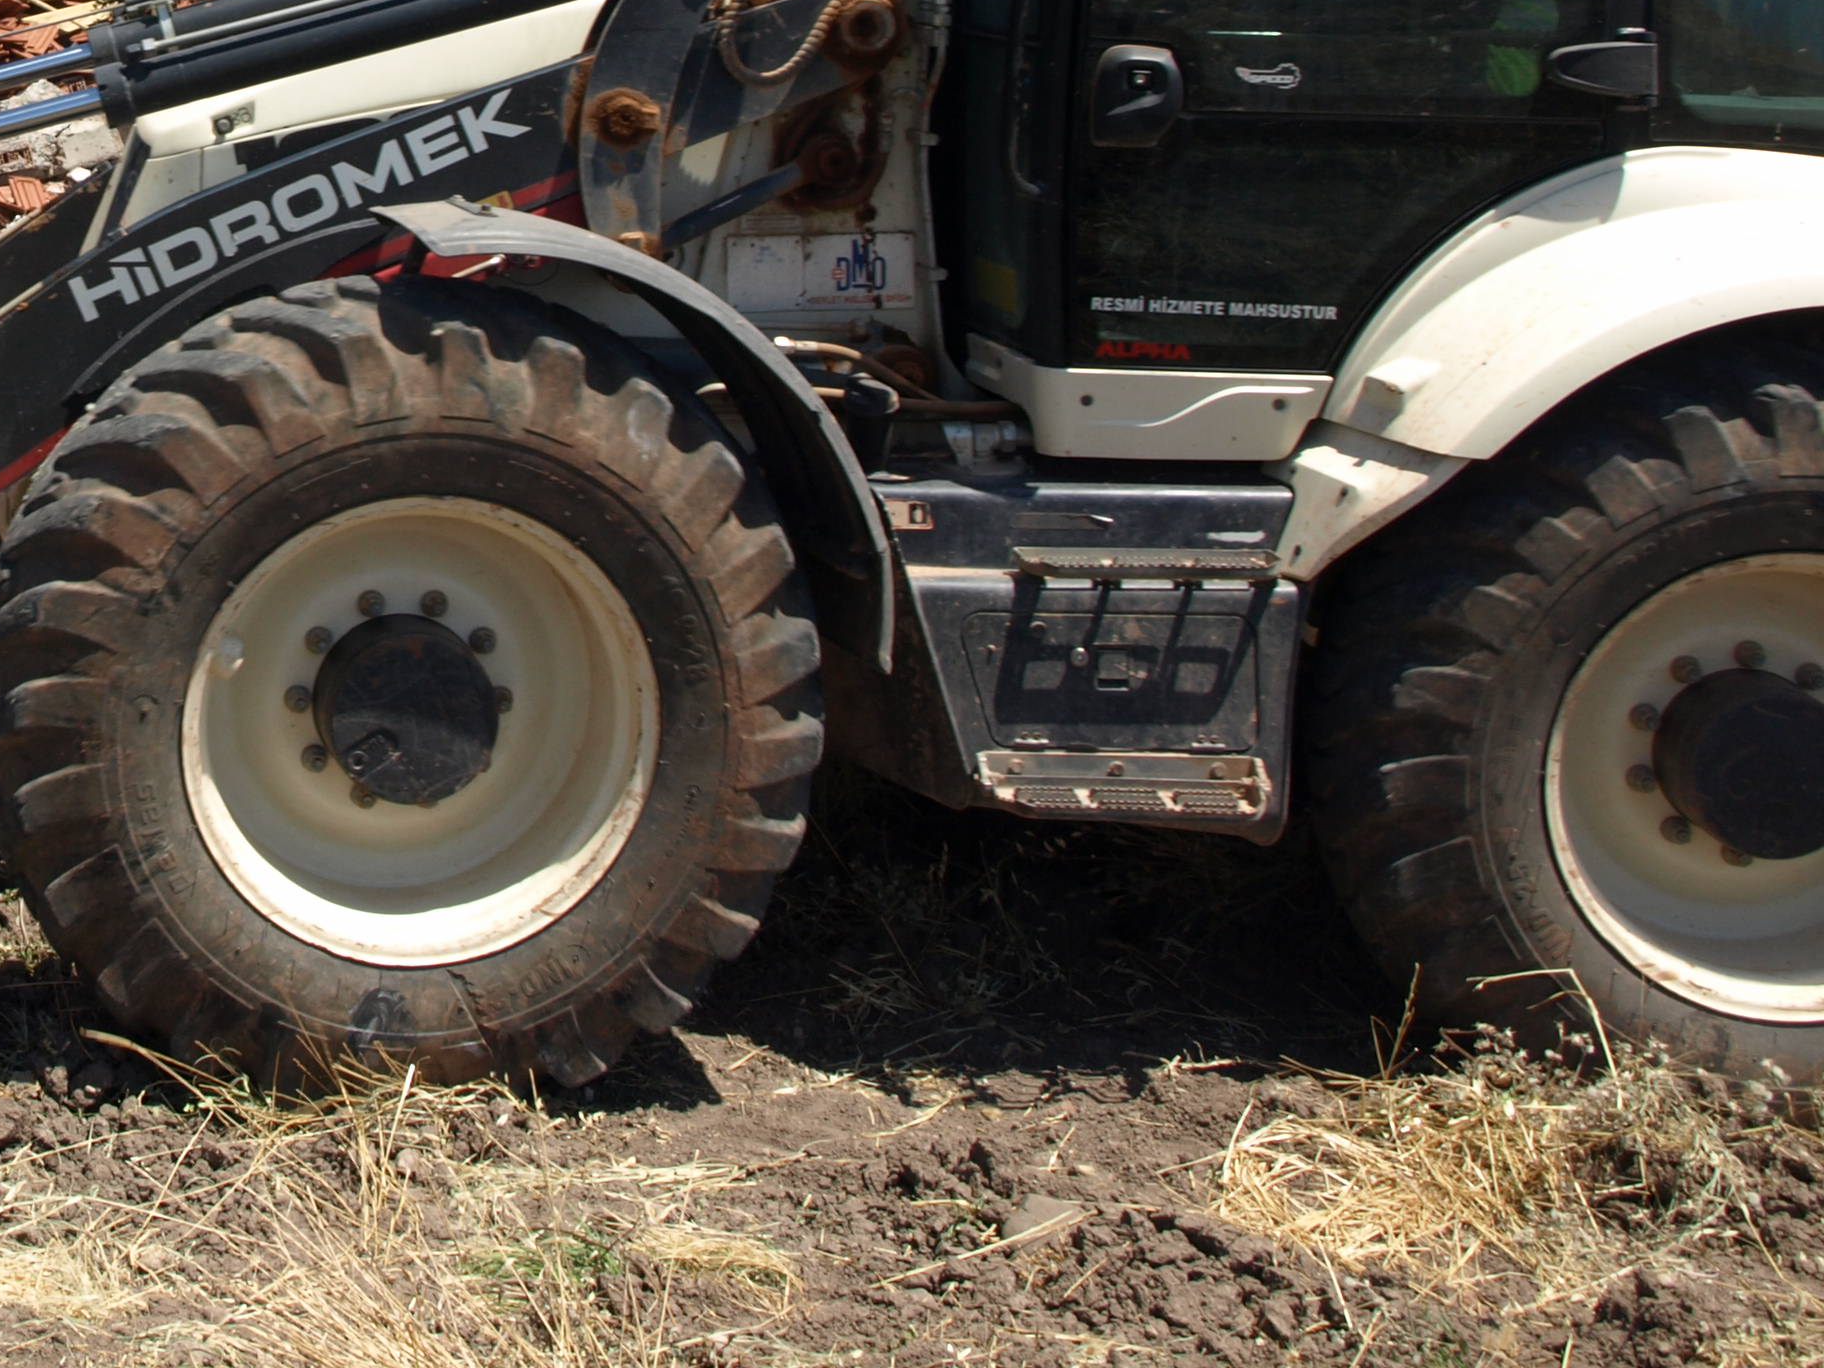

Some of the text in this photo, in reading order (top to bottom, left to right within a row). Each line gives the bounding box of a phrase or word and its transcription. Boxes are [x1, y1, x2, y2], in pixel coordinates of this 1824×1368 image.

[1089, 295, 1338, 320] RESMİ HİZMETE MAHSUSTUR
[1095, 340, 1191, 360] ALPHA
